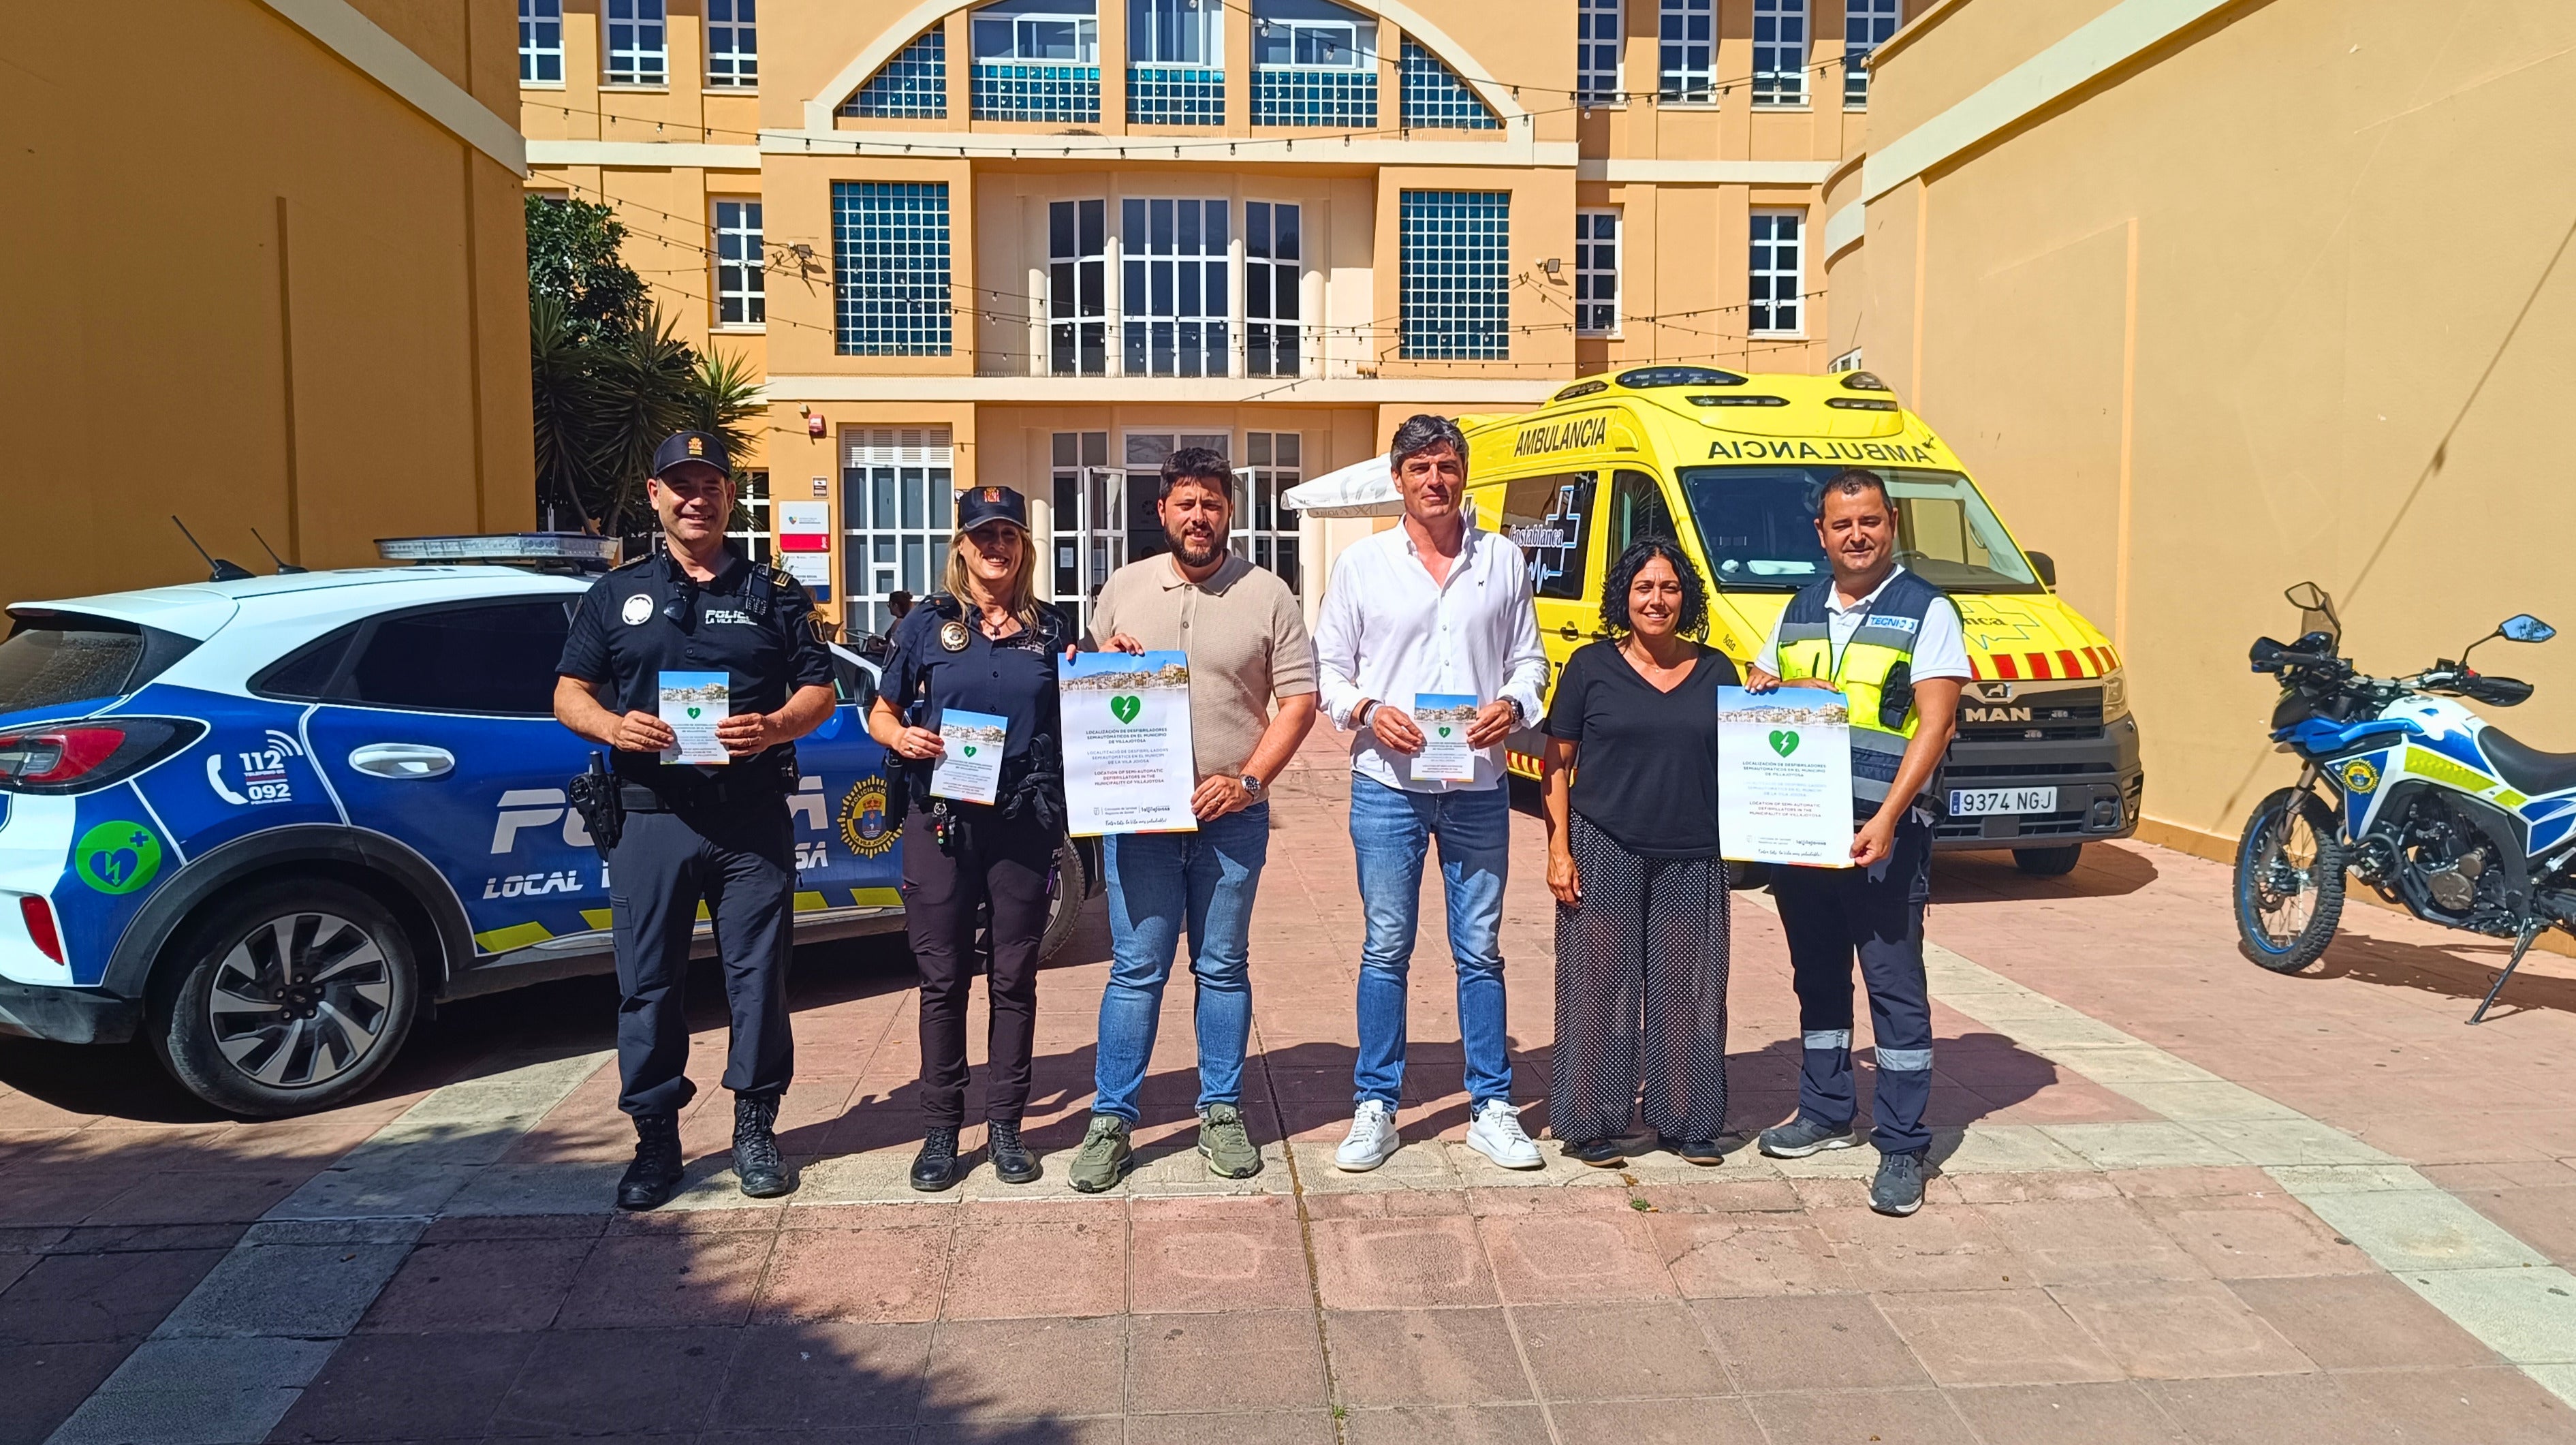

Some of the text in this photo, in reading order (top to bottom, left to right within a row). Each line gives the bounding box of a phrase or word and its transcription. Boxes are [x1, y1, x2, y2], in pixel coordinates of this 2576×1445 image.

[1514, 417, 1606, 457] AMBULANCIA
[1509, 524, 1564, 548] Costablanca
[705, 610, 749, 619] POLIC
[1965, 707, 2031, 722] MAN
[239, 750, 284, 771] 112
[248, 783, 292, 800] 092
[851, 787, 874, 807] POLICIA
[1964, 793, 2010, 812] 9374
[2017, 791, 2052, 810] NGJ
[483, 871, 583, 899] LOCAL
